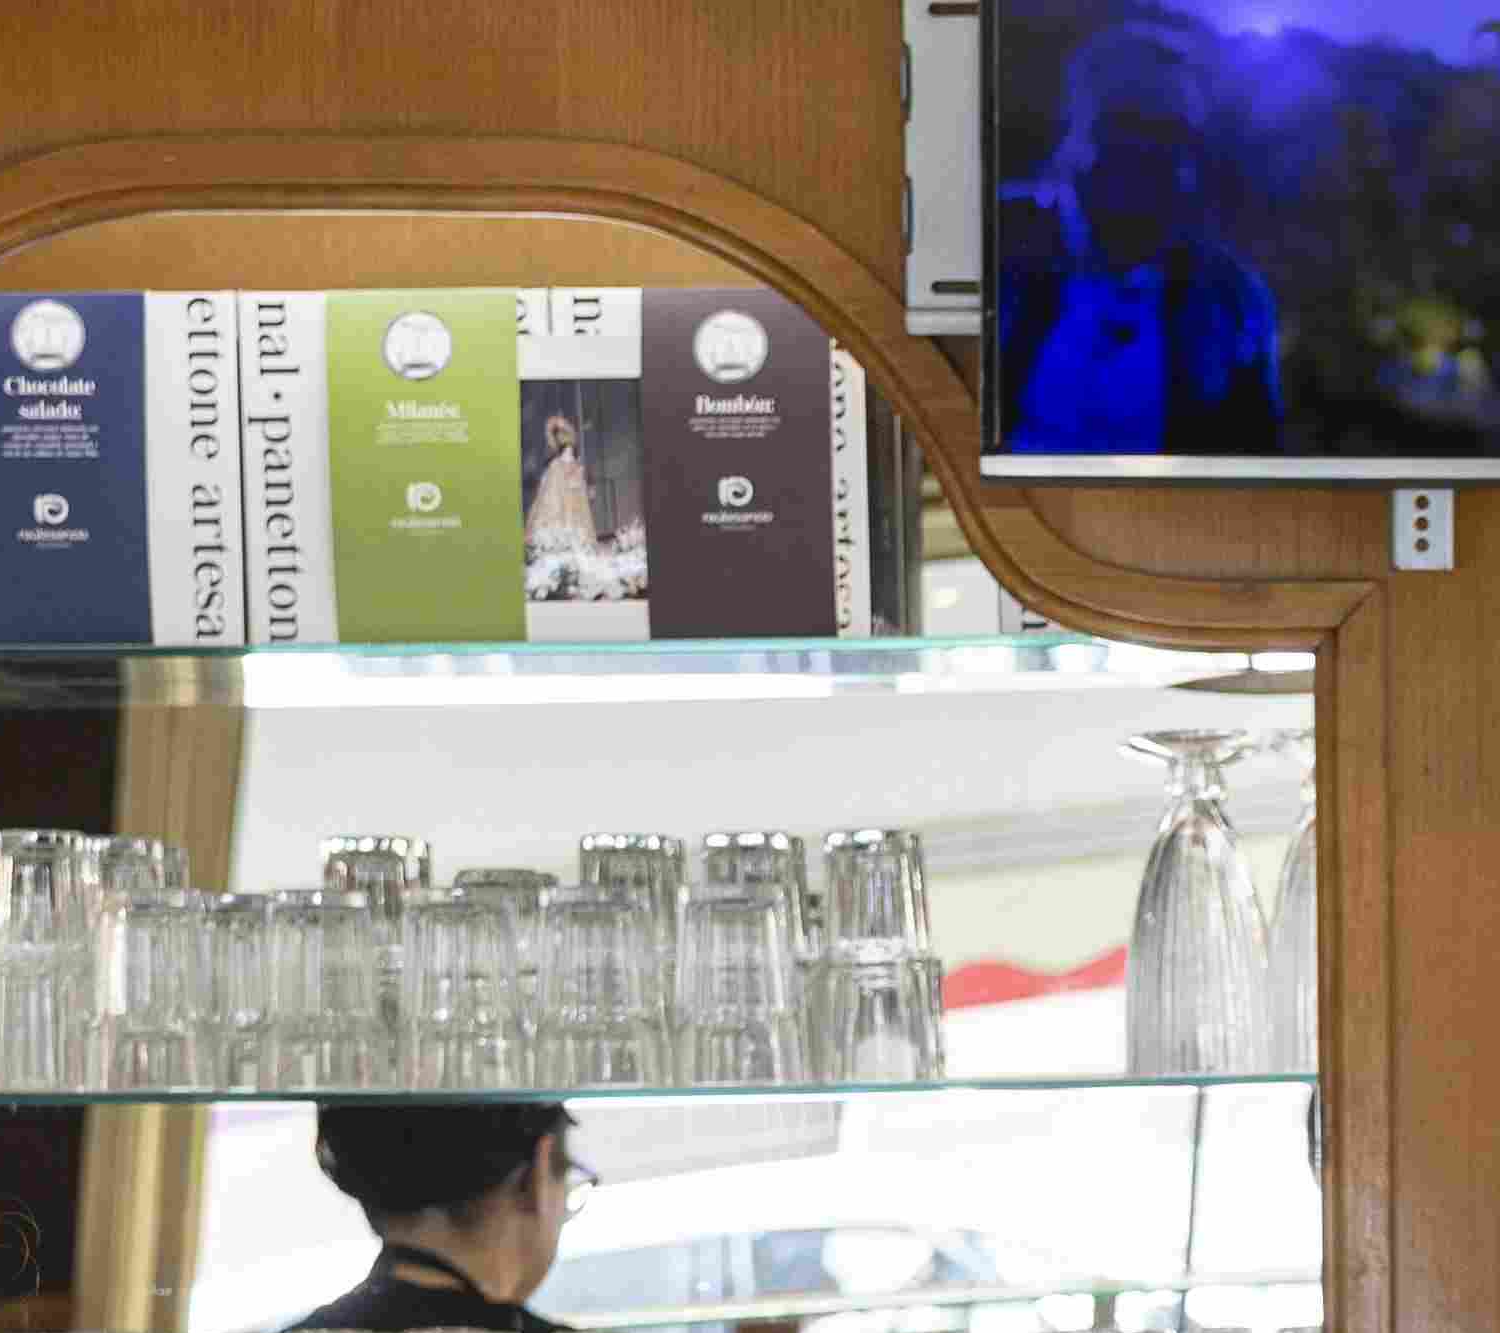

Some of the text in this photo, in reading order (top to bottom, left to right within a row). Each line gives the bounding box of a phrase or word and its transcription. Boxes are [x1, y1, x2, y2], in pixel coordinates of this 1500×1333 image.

[2, 375, 97, 397] Chocolate
[187, 297, 227, 641] ettone artesa
[247, 302, 303, 644] nal panetton
